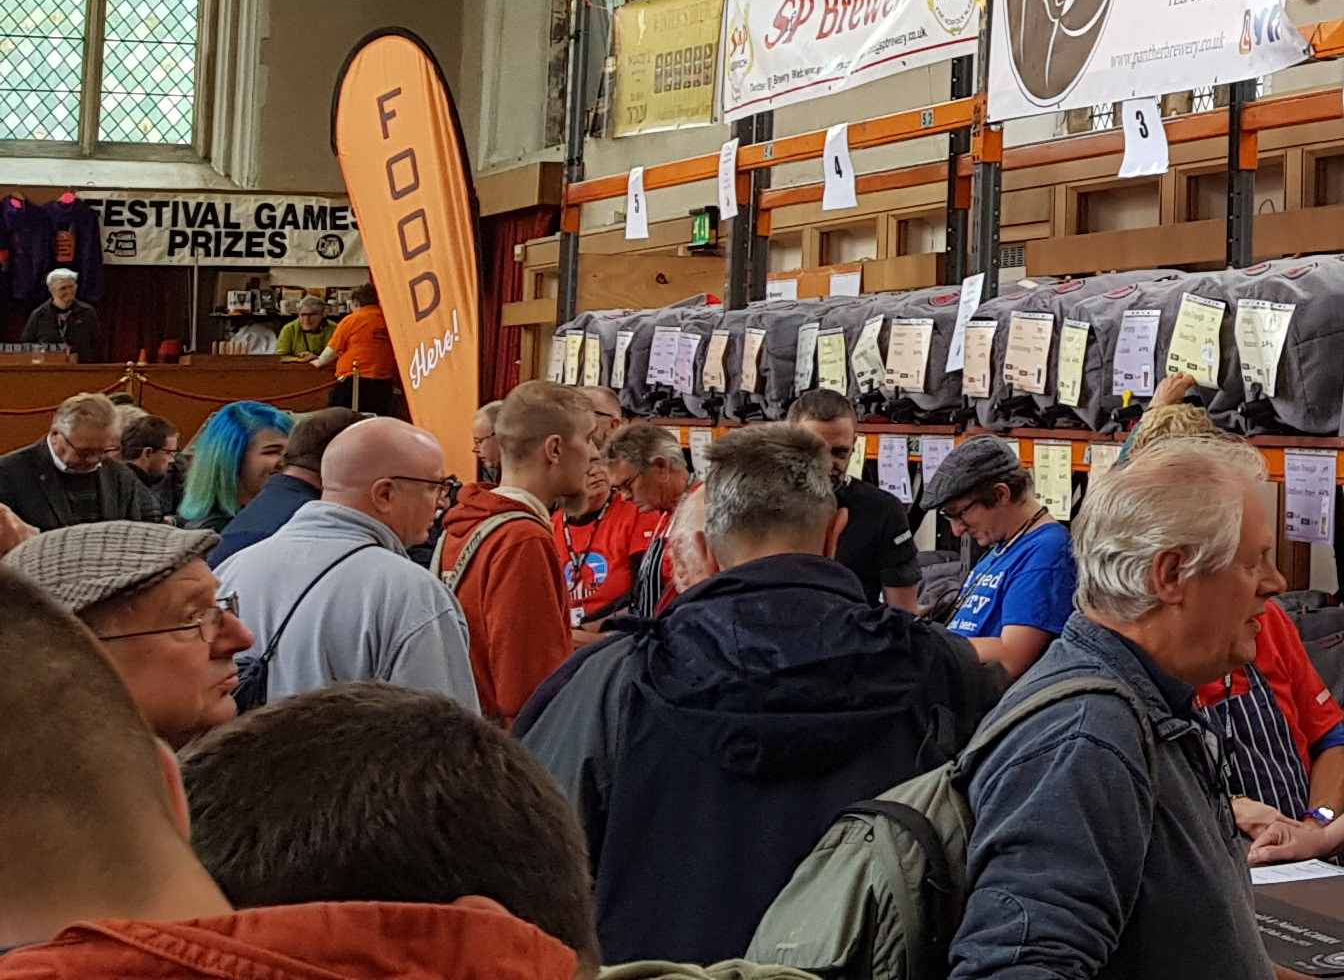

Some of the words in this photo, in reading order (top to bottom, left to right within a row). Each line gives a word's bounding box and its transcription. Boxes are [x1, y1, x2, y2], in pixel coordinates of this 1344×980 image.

[1110, 32, 1224, 69] www.pantherbrewery.co.uk
[1135, 110, 1150, 139] 3
[835, 156, 842, 178] 4
[376, 88, 441, 322] FOOD
[634, 194, 640, 213] 5
[167, 230, 287, 258] PRIZES
[409, 310, 460, 389] Here!
